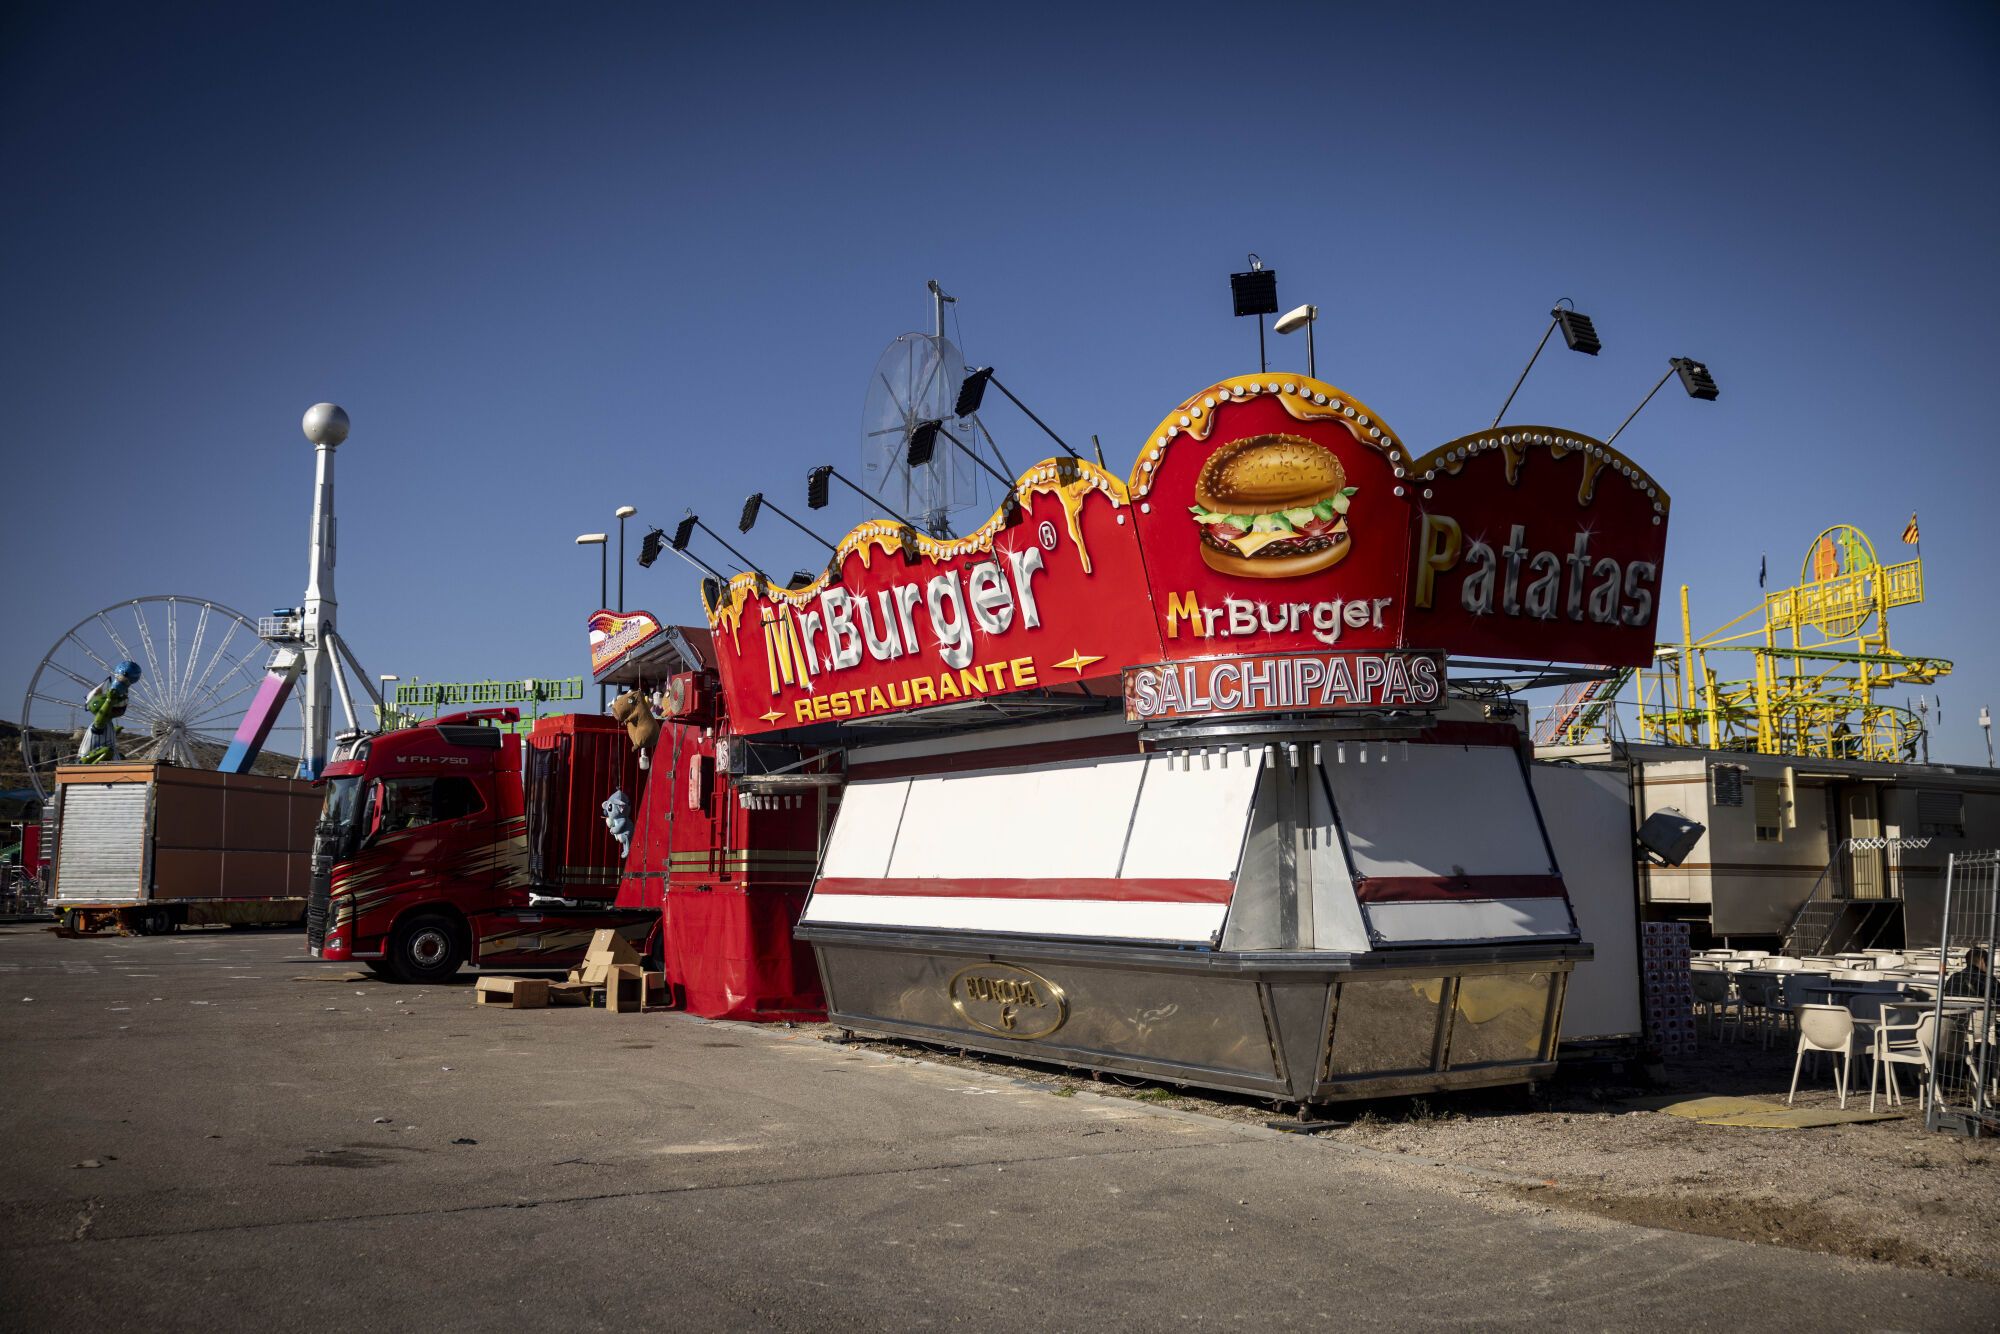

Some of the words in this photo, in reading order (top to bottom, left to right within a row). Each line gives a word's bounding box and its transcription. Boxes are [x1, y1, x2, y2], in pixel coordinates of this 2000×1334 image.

[1415, 514, 1656, 626] Patatas
[1167, 590, 1392, 644] Mr.Burger
[794, 656, 1038, 723] RESTAURANTE
[1135, 656, 1438, 716] SALCHIPAPAS
[410, 756, 469, 765] FH-750
[966, 976, 1047, 1009] EUROPA
